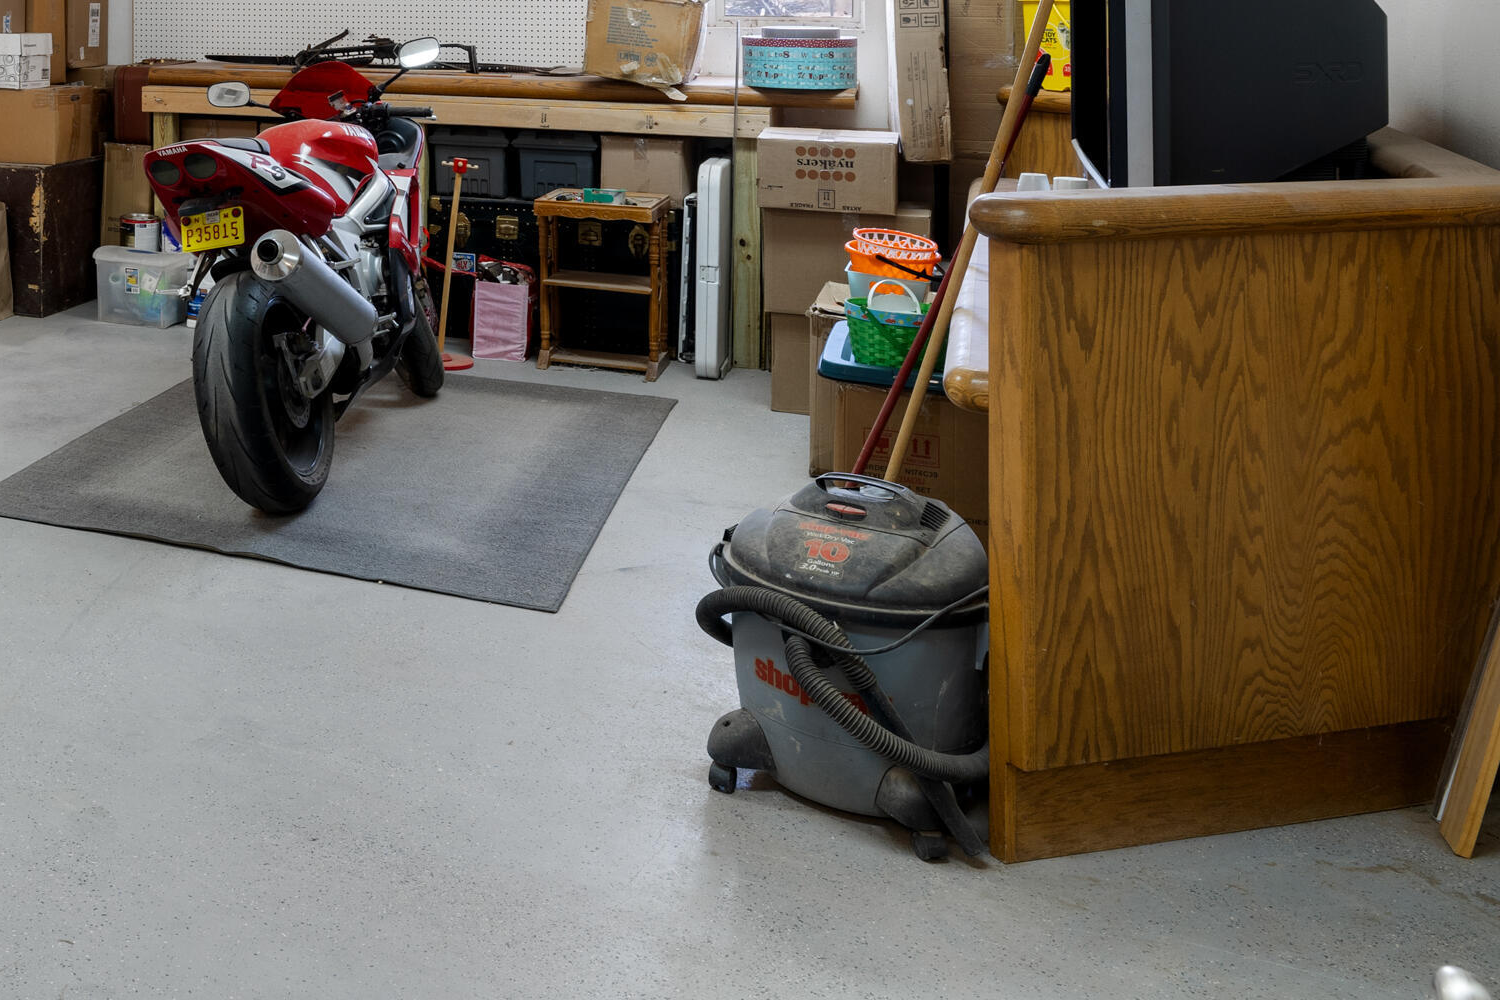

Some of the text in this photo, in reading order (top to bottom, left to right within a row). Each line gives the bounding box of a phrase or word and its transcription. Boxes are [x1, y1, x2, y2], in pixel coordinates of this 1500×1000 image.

[156, 145, 188, 157] YAMAHA
[186, 221, 239, 246] P35815
[803, 538, 851, 563] 10
[806, 558, 835, 568] Gallons
